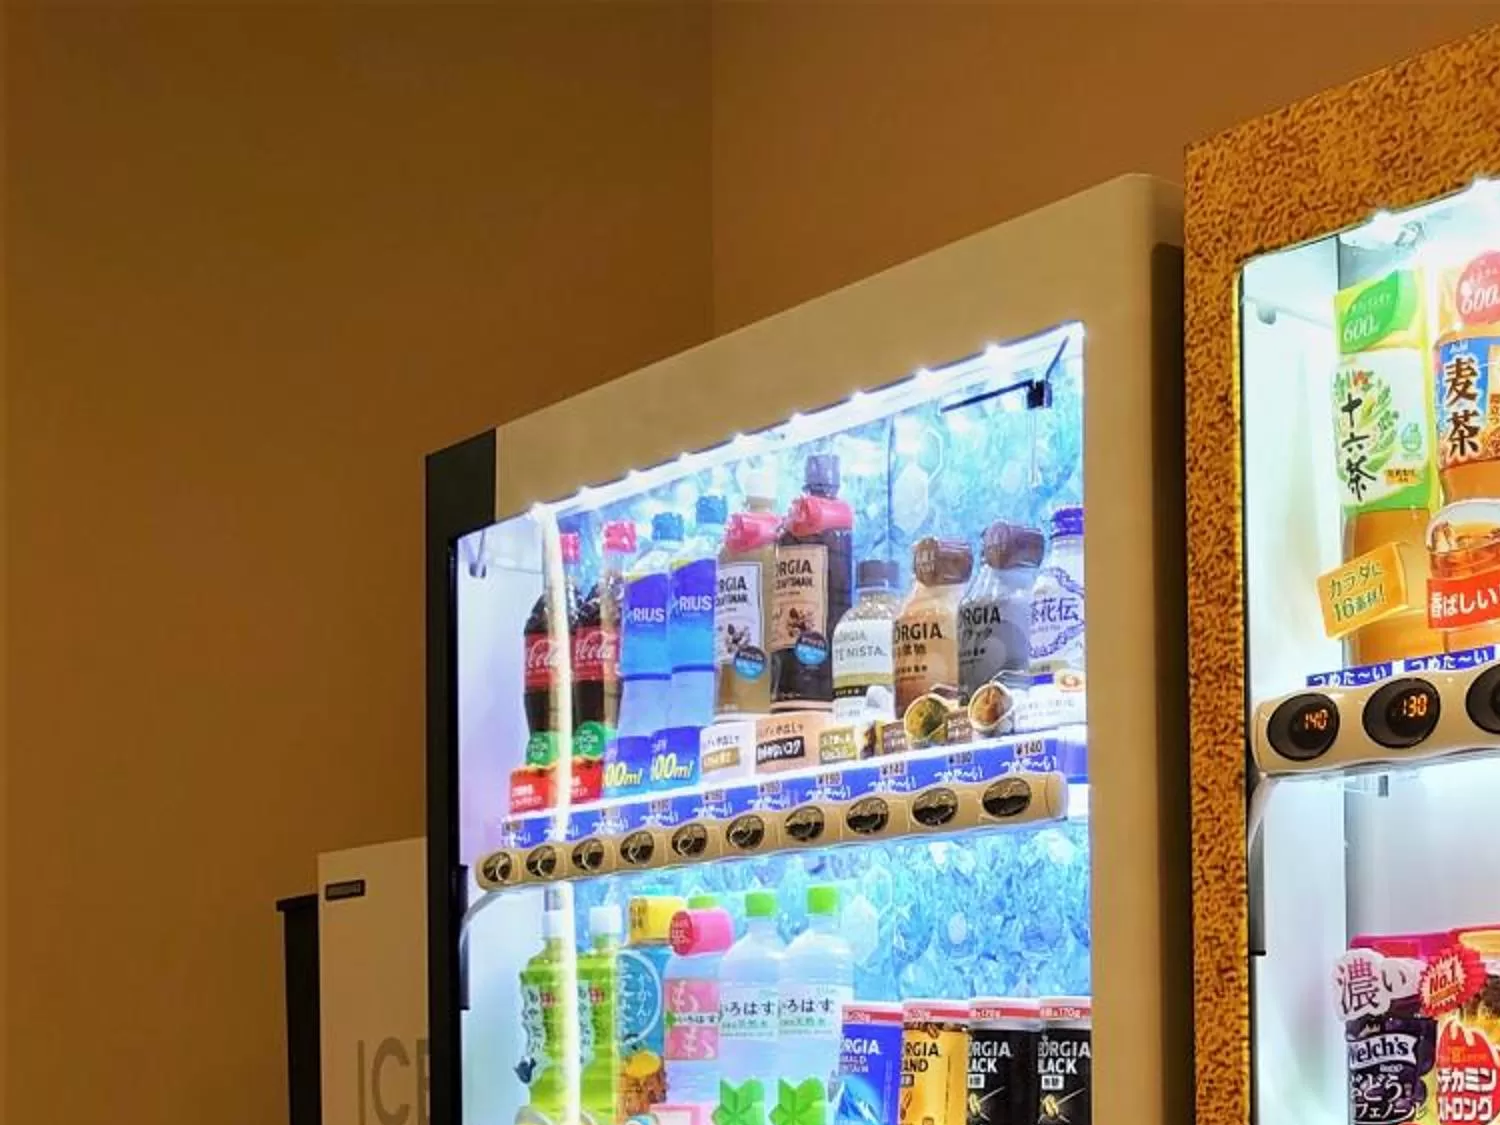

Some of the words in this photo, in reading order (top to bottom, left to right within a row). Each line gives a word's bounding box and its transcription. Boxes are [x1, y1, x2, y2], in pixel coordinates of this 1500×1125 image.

[1444, 357, 1482, 458] 麦茶
[1342, 395, 1377, 501] 十六茶
[1303, 709, 1328, 731] 140
[1403, 696, 1428, 719] 130
[1337, 957, 1407, 1014] 濃い
